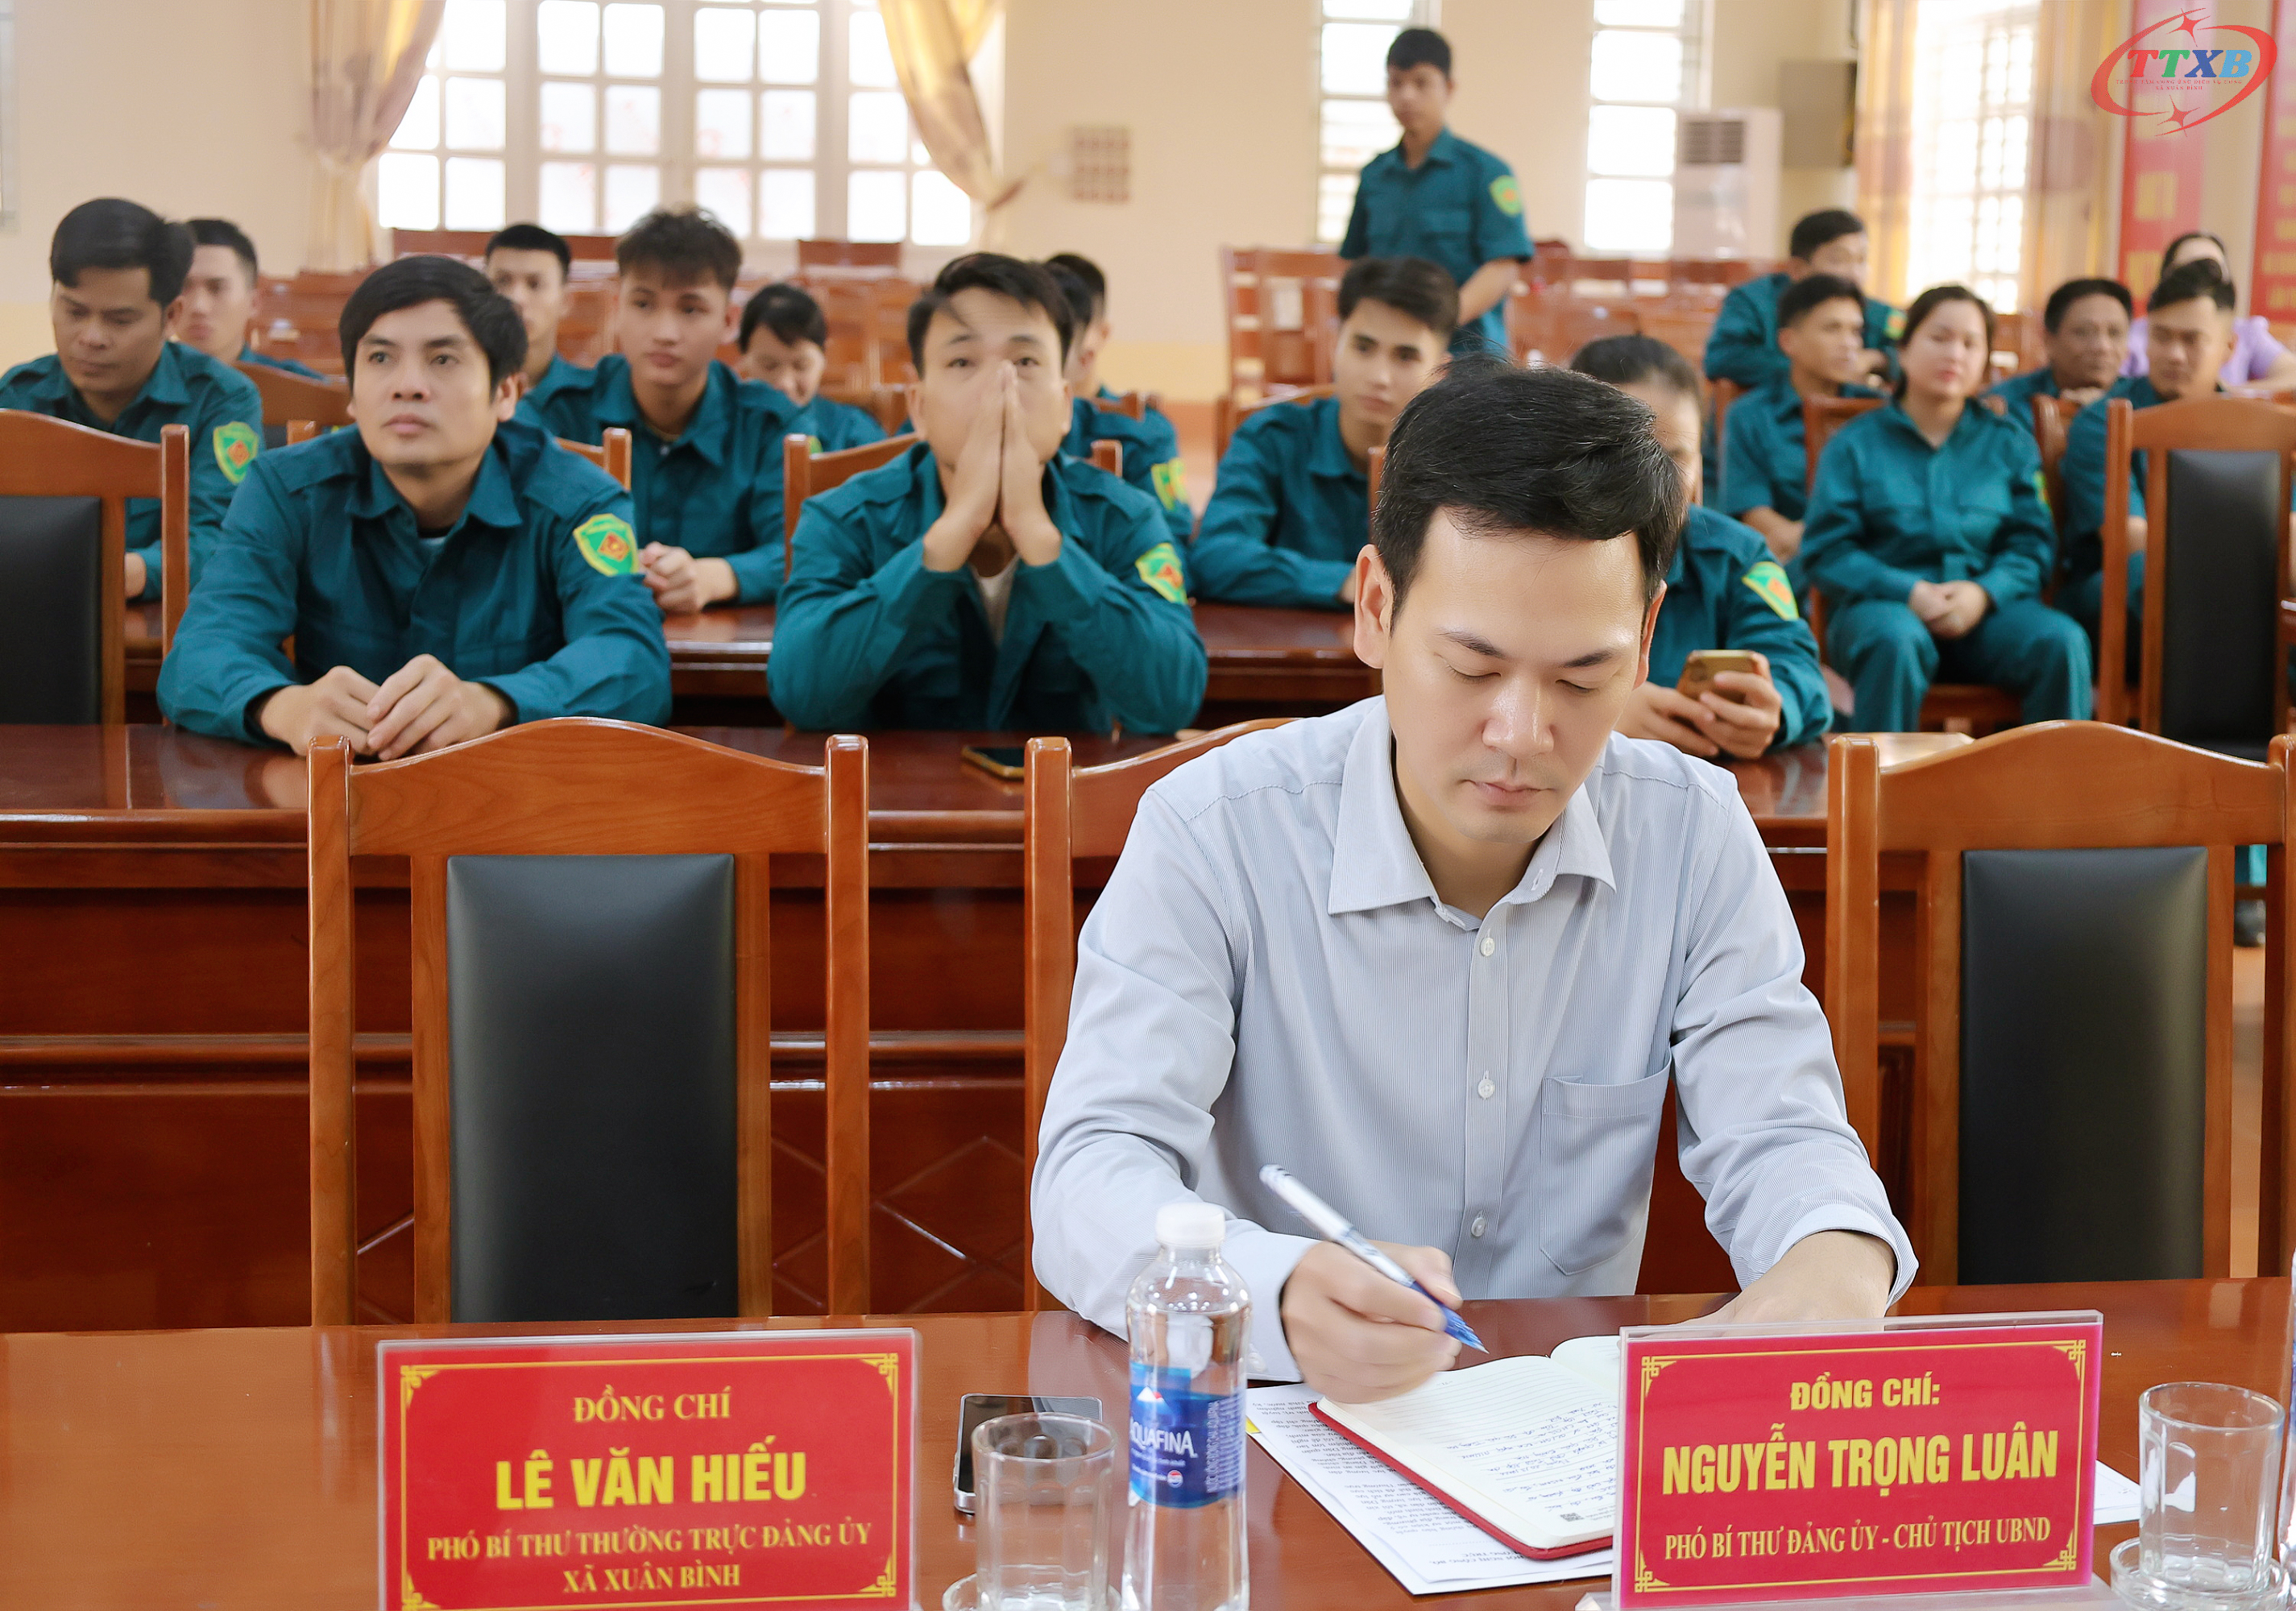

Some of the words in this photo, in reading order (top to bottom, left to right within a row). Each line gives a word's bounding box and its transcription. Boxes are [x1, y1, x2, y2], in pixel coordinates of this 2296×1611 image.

[574, 1384, 665, 1423] ĐỒNG
[673, 1385, 731, 1419] CHÍ
[1790, 1371, 1872, 1410] ĐỒNG
[1882, 1371, 1940, 1407] CHÍ:
[495, 1449, 554, 1510] LÊ
[570, 1447, 674, 1507] VĂN
[691, 1435, 806, 1504] HIẾU
[1662, 1423, 1816, 1495] NGUYỄN
[1828, 1434, 1950, 1497] TRỌNG
[1962, 1421, 2059, 1481] LUÂN
[427, 1529, 481, 1561] PHÓ
[485, 1527, 511, 1559] BÍ
[516, 1531, 570, 1556] THƯ
[574, 1522, 682, 1555] THƯỜNG
[688, 1526, 756, 1556] TRỰC
[762, 1518, 831, 1549] ĐẢNG
[839, 1515, 872, 1546] ỦY
[1664, 1526, 1707, 1560] PHÓ
[1711, 1524, 1734, 1559] BÍ
[1738, 1525, 1784, 1556] THƯ
[1787, 1521, 1846, 1555] ĐẢNG
[1850, 1518, 1879, 1551] ỦY
[1894, 1514, 1940, 1550] CHỦ
[1942, 1518, 1990, 1552] TỊCH
[1996, 1516, 2051, 1545] UBND
[563, 1564, 598, 1593] XÃ
[604, 1561, 673, 1592] XUÂN
[679, 1559, 741, 1588] BÌNH
